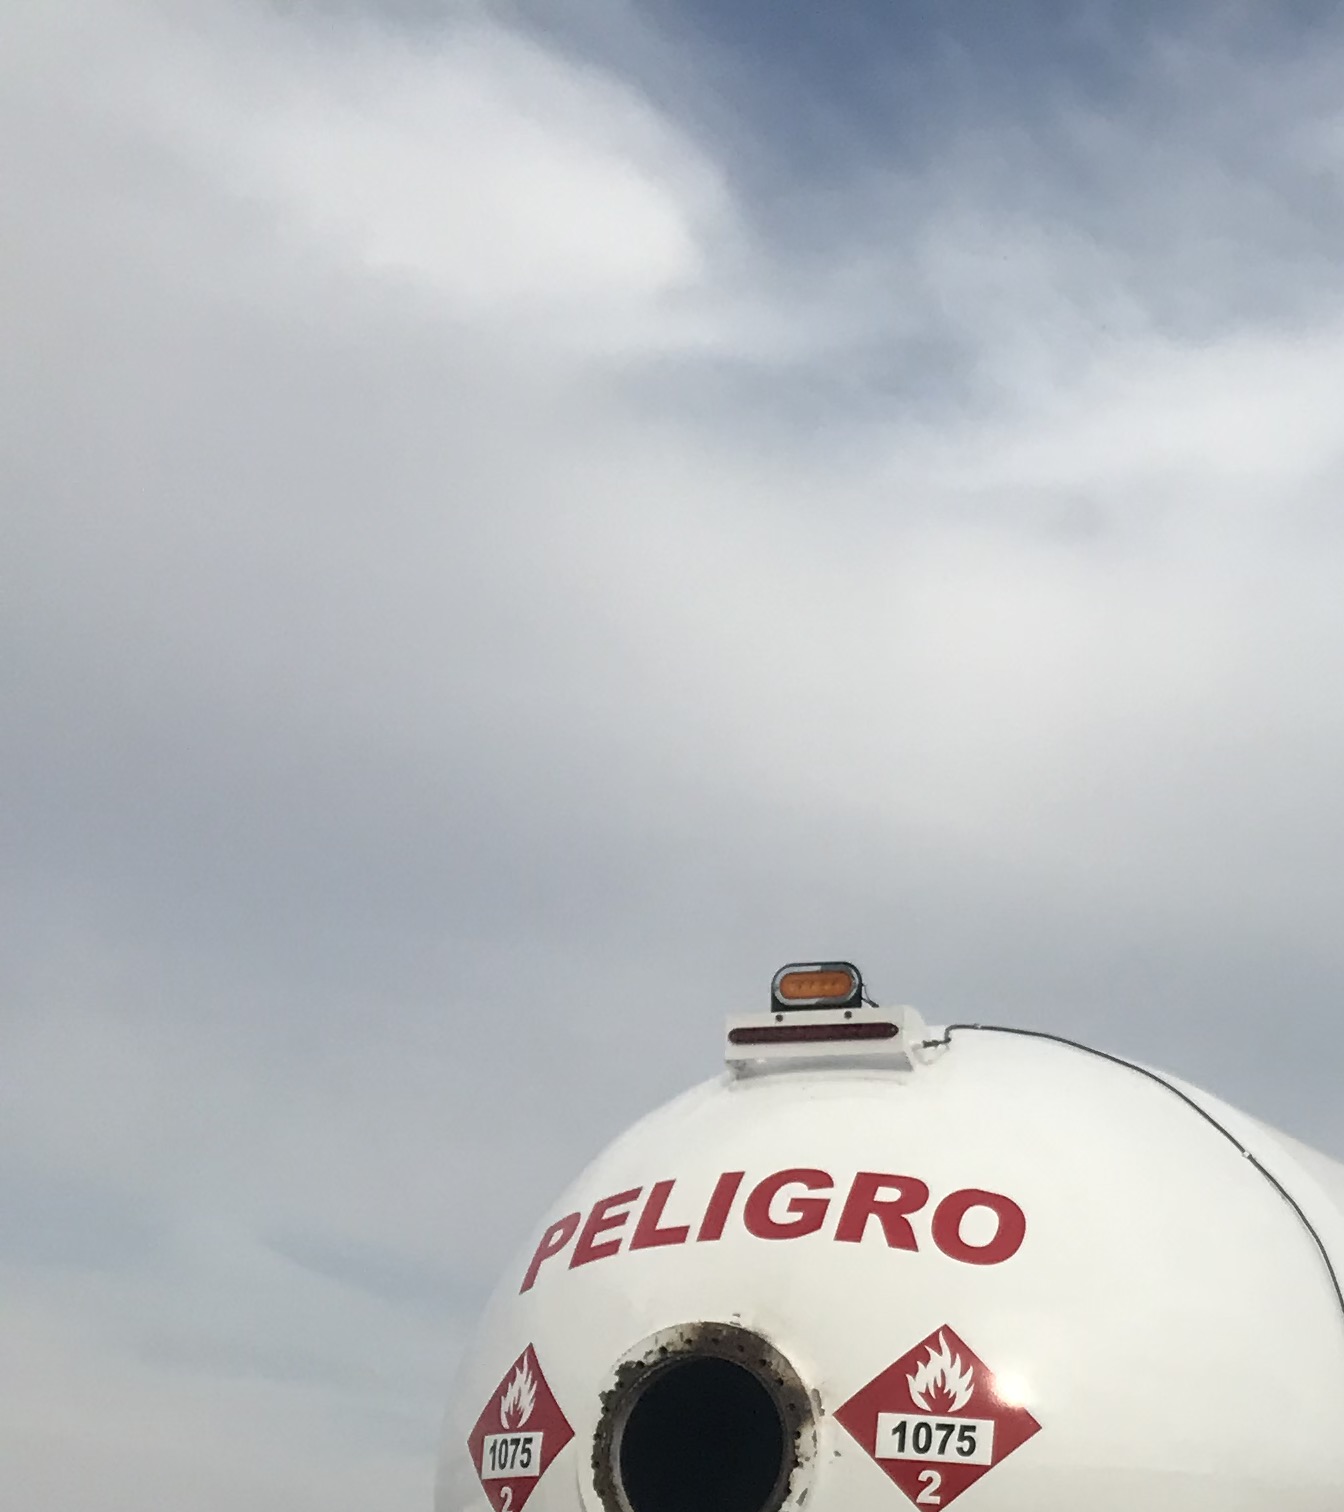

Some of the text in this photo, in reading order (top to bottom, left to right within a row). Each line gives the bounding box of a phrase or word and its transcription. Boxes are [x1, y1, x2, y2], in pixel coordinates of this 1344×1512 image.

[520, 1168, 1026, 1294] PELIGRO
[488, 1437, 533, 1472] 1075
[890, 1420, 977, 1458] 1075
[916, 1470, 942, 1505] 2
